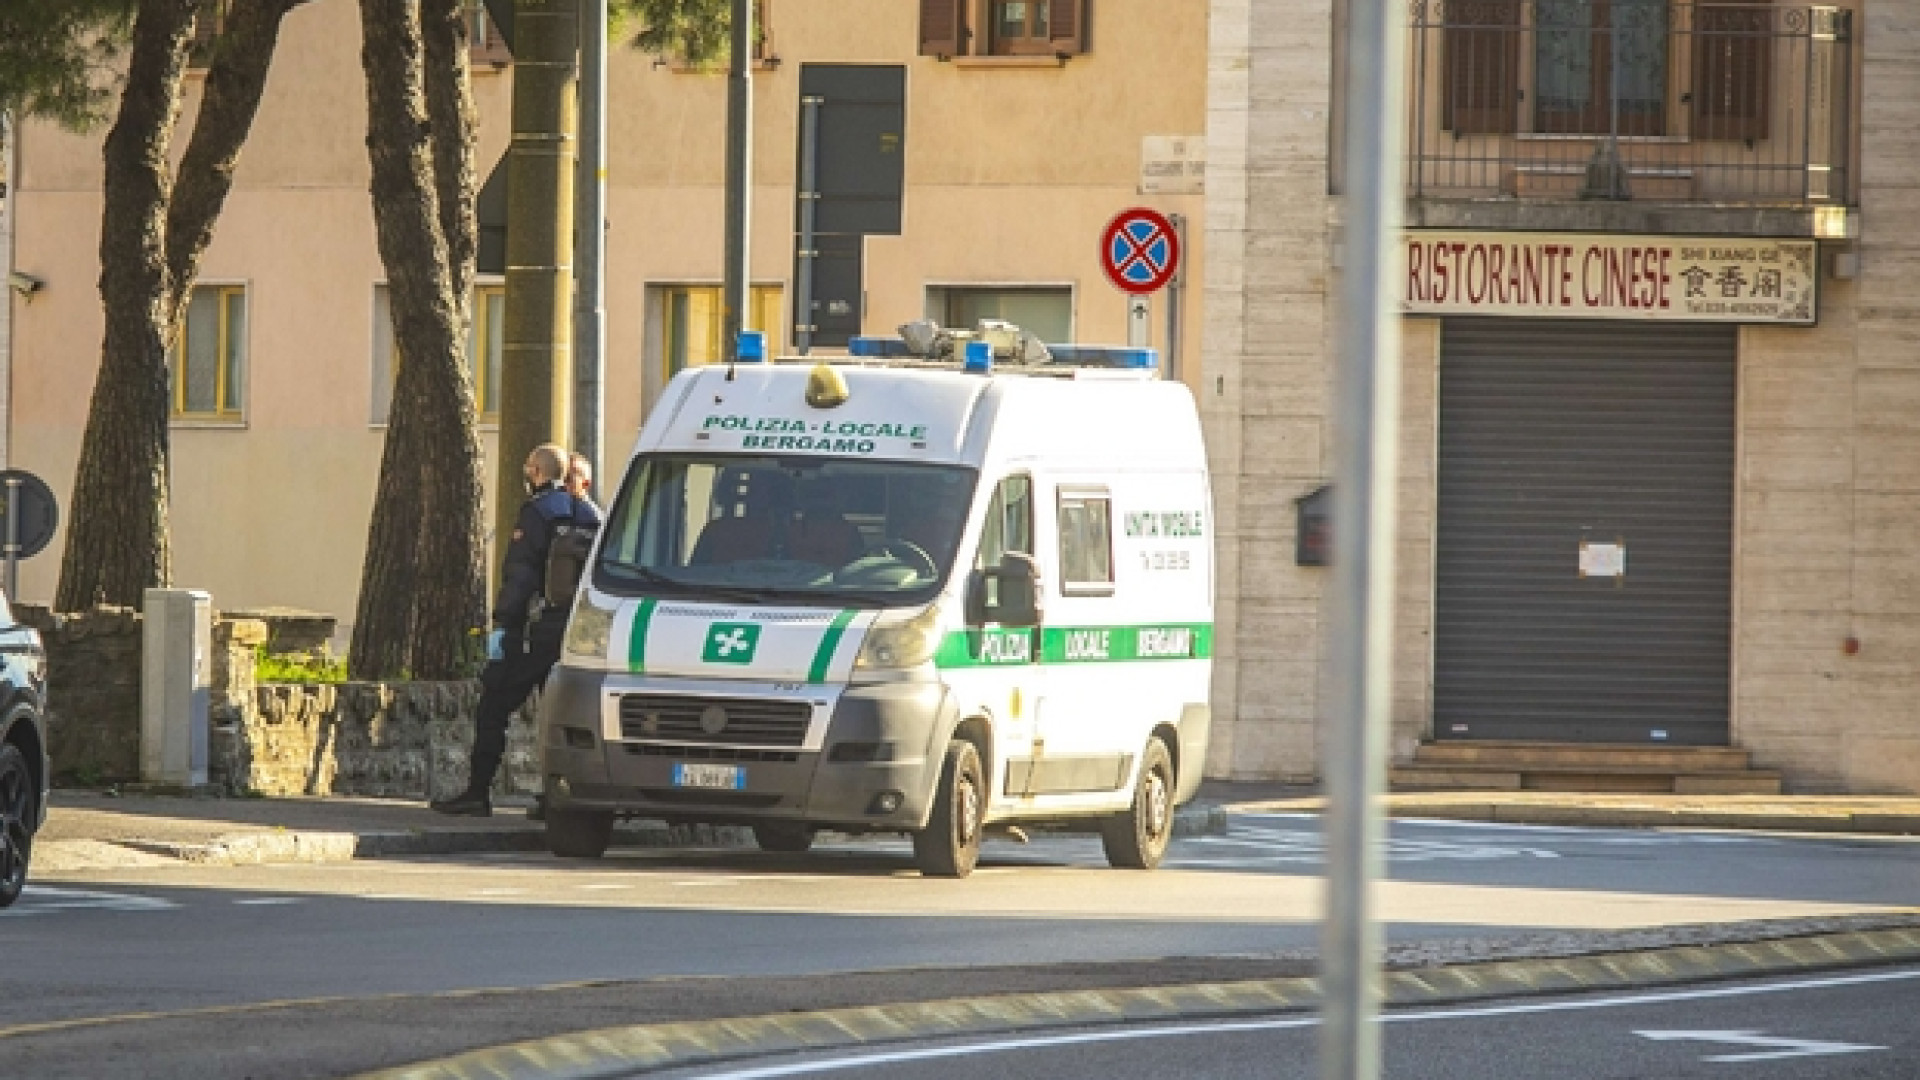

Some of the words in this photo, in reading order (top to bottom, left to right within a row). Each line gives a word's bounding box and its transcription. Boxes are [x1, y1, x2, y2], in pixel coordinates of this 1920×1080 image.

[1681, 248, 1707, 261] SHI
[1709, 248, 1756, 262] XIANG
[1408, 242, 1573, 306] RISTORANTE
[1582, 245, 1671, 309] CINESE
[703, 415, 806, 433] POLIZIA
[823, 420, 927, 438] LOCALE
[742, 435, 875, 452] BERGAMO
[981, 632, 1029, 663] POLIZIA
[1064, 630, 1109, 660] LOCALE
[1137, 628, 1195, 658] BERGAM
